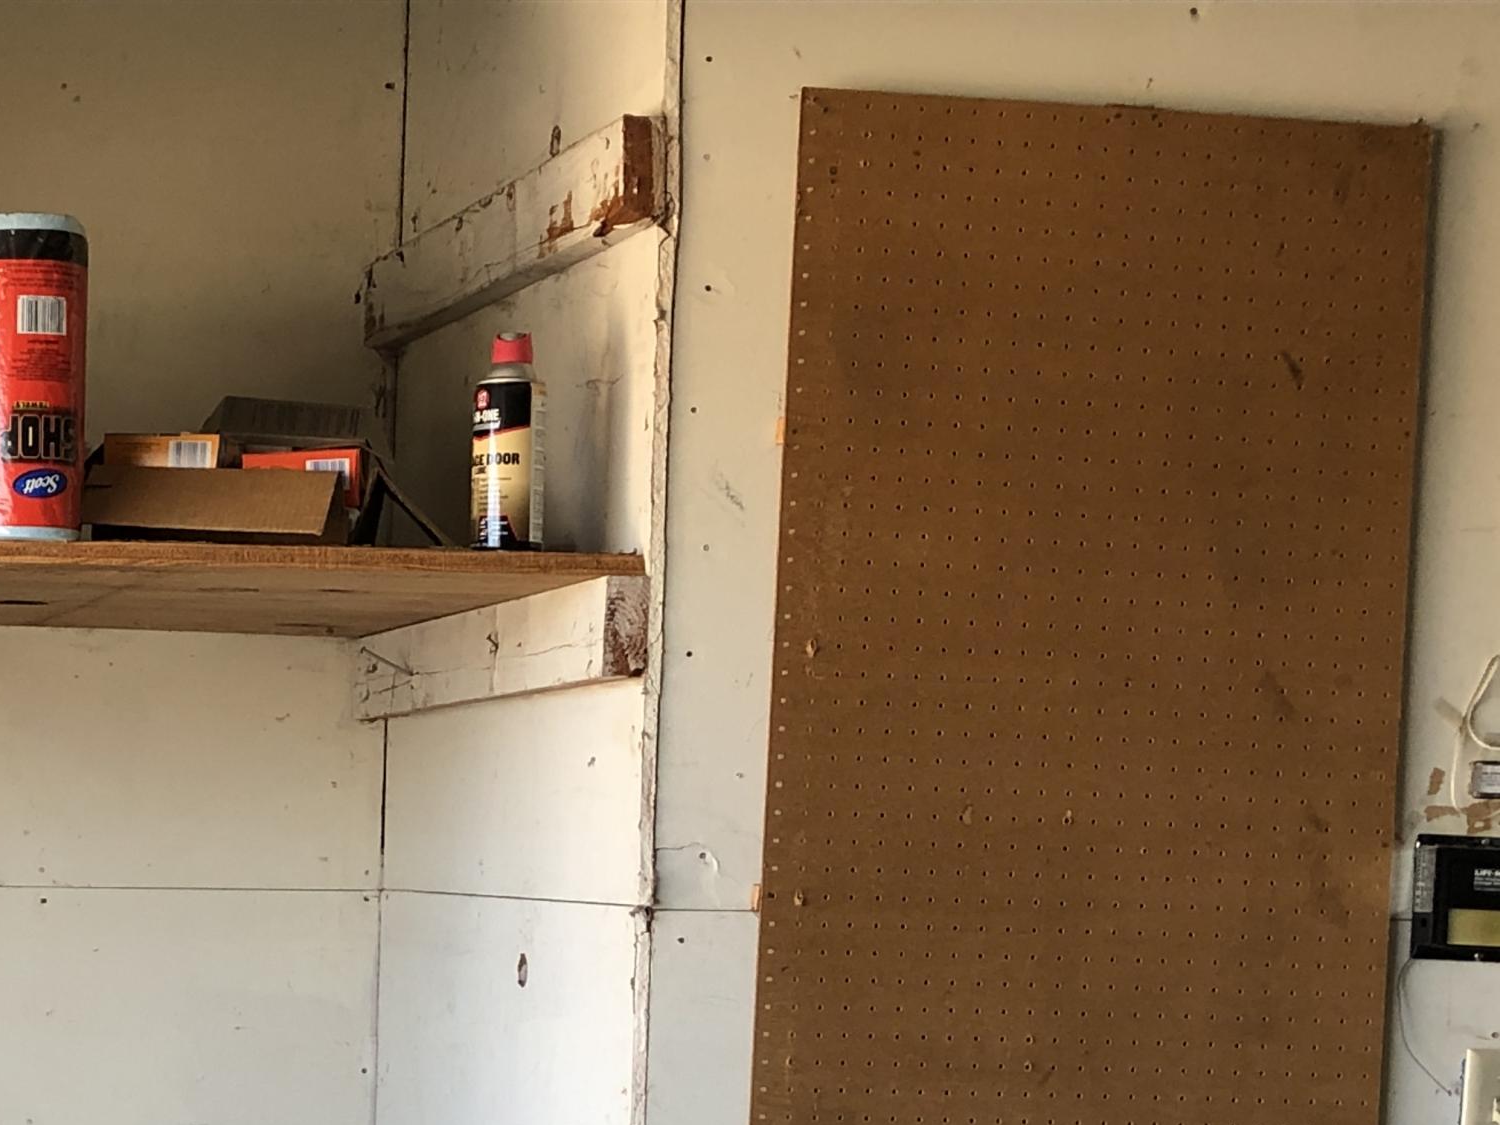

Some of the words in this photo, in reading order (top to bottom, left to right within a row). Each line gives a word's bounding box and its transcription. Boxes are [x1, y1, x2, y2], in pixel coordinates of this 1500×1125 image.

[0, 414, 76, 461] SHOP
[486, 453, 520, 465] DOOR
[23, 474, 60, 494] Scott
